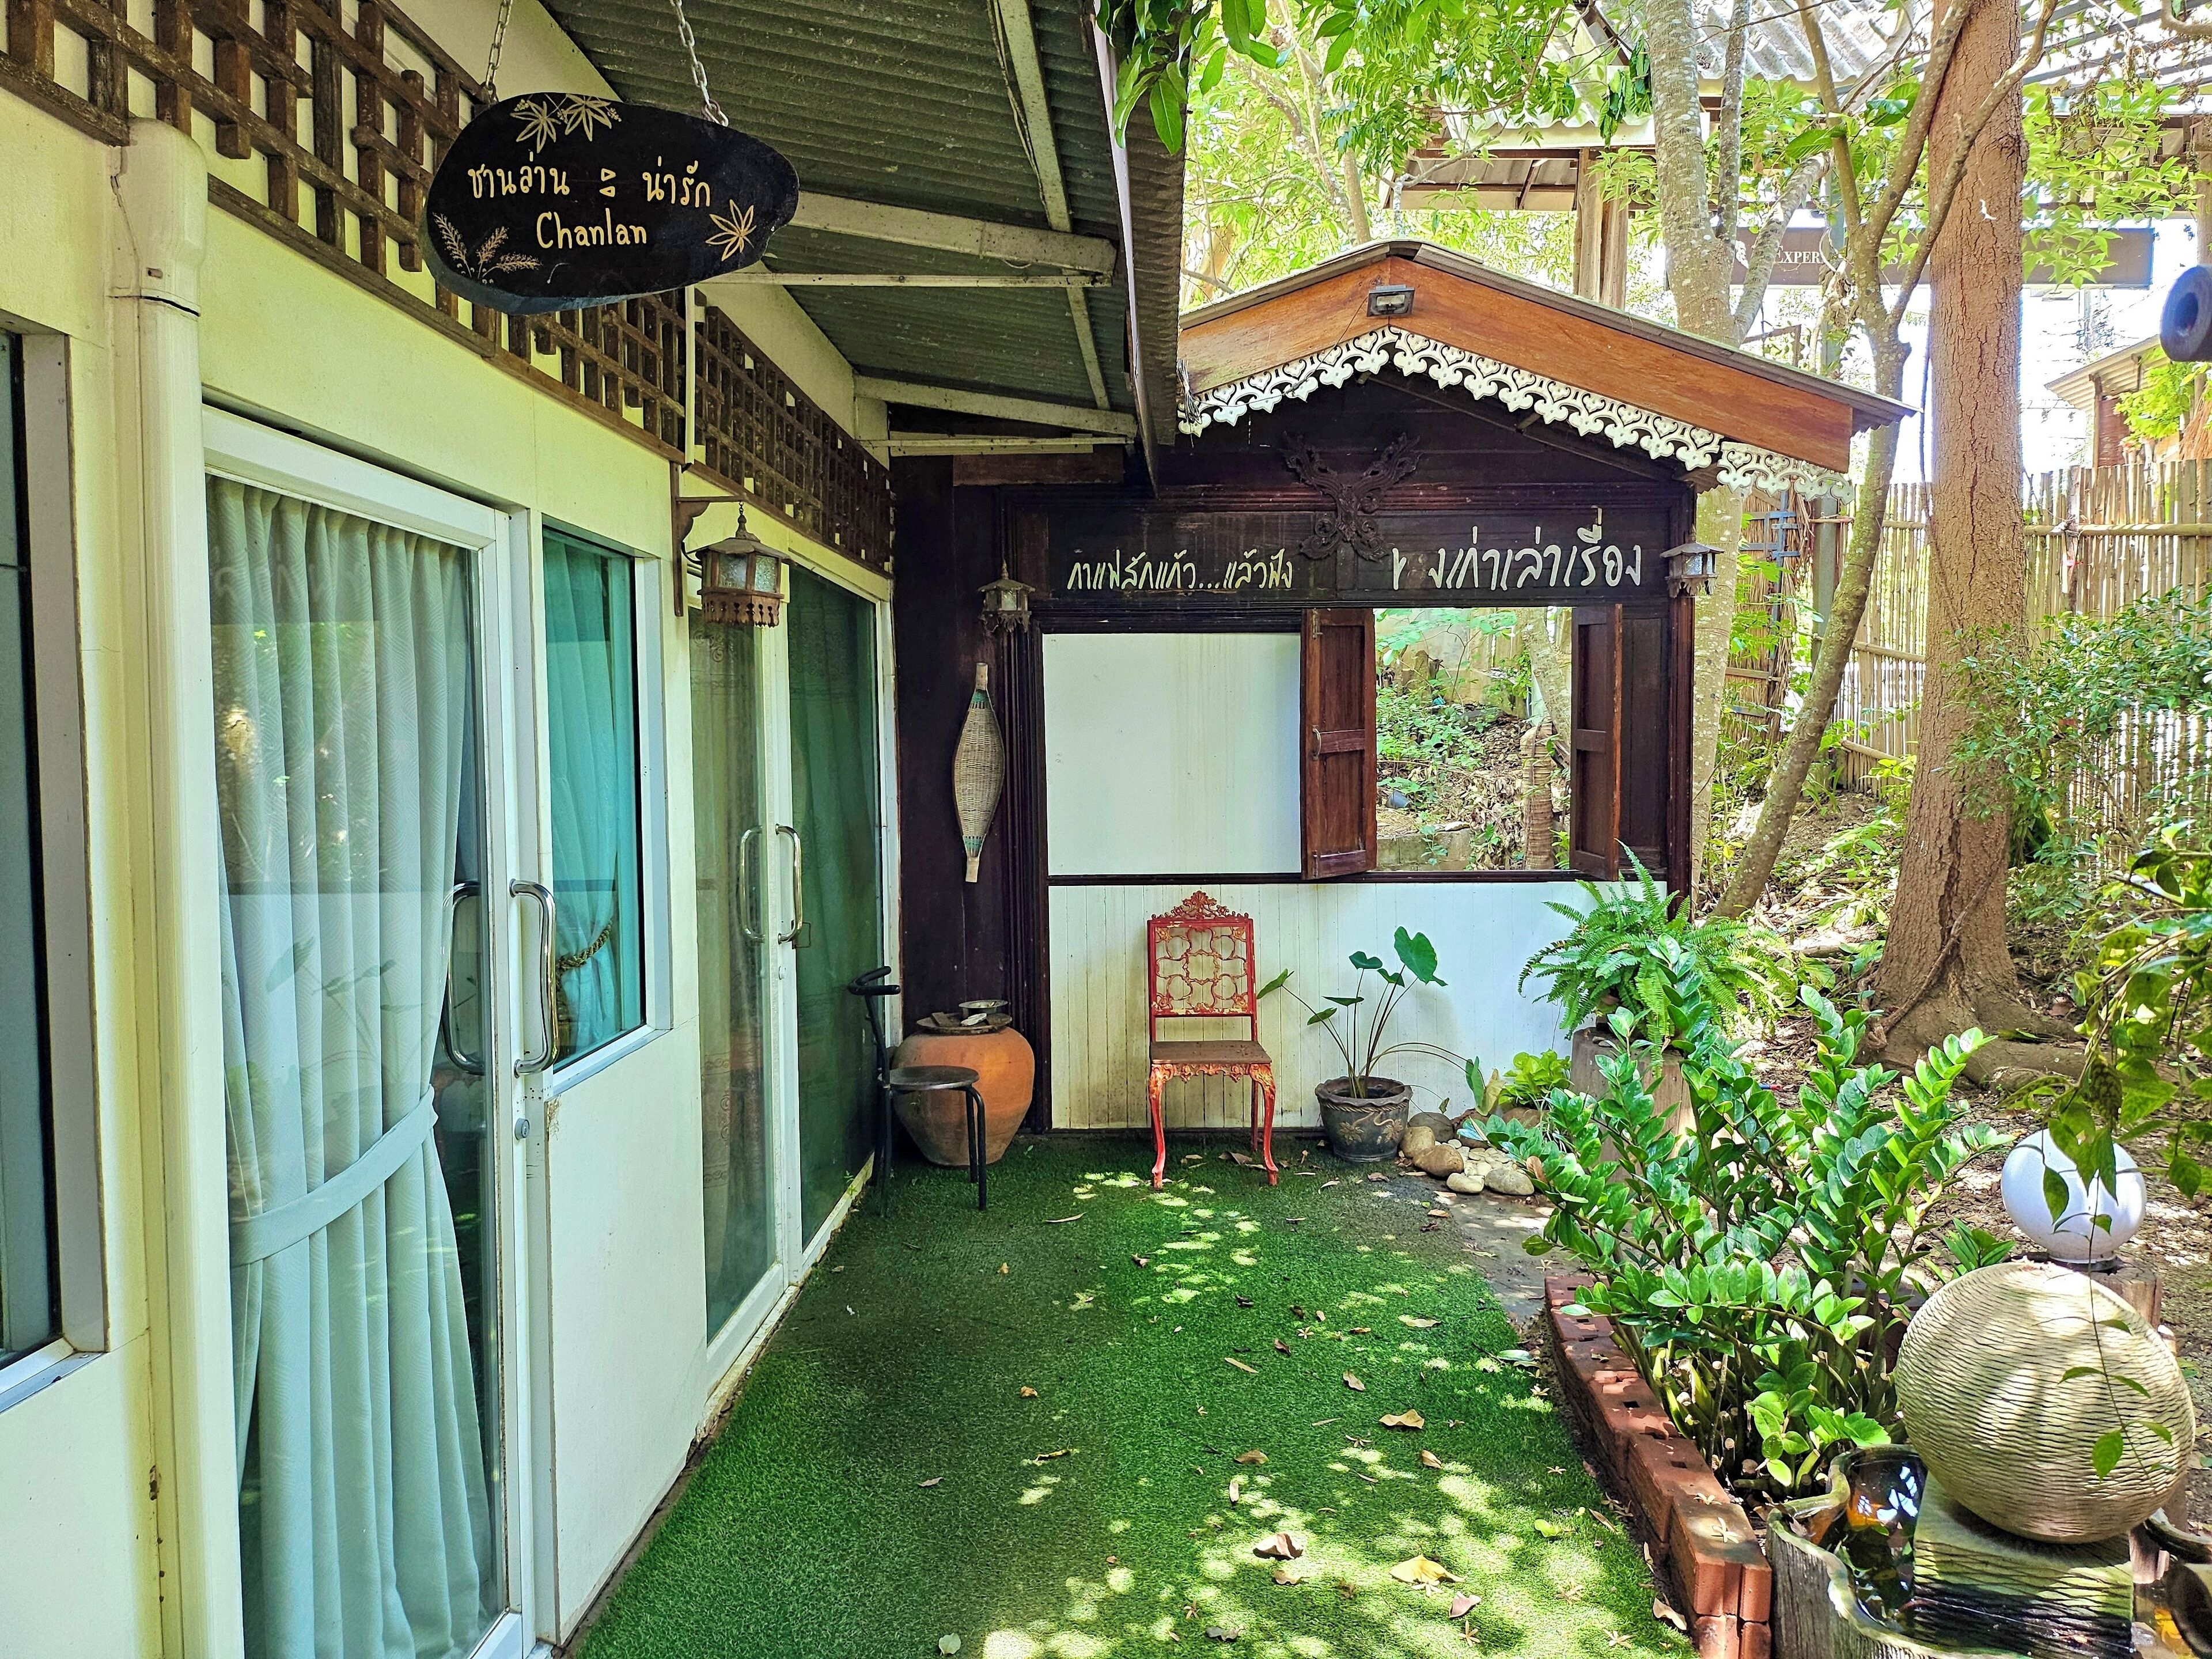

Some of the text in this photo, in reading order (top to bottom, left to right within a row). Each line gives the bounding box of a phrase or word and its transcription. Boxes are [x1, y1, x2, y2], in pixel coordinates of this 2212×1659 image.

[467, 151, 570, 199] ชานล่าน
[642, 155, 710, 208] น่ารัก
[536, 207, 647, 249] Chanlan
[1774, 244, 1824, 264] EXPER
